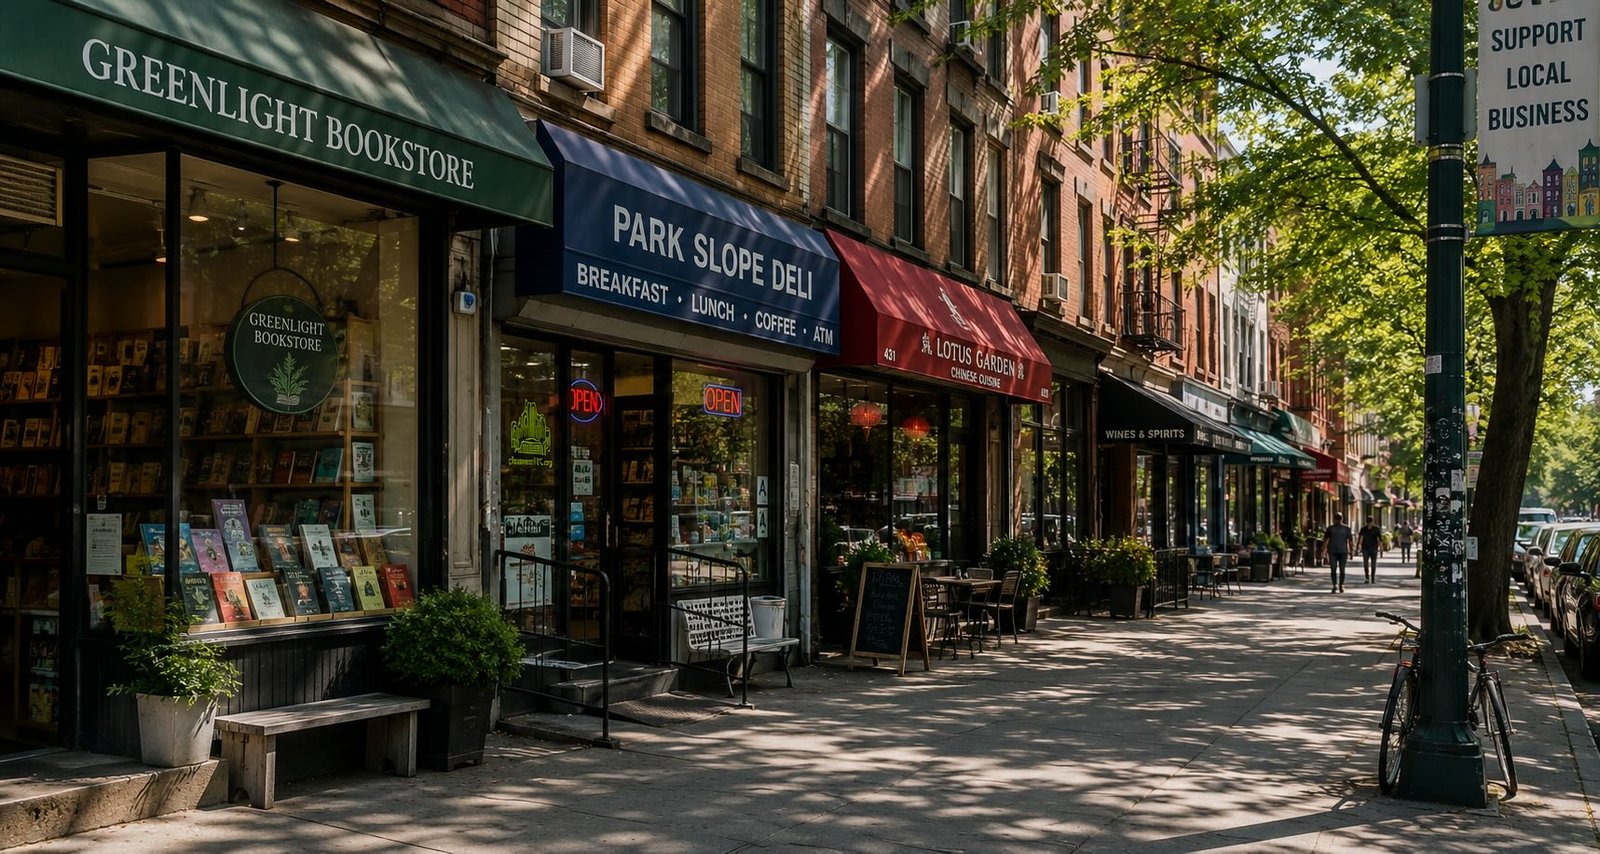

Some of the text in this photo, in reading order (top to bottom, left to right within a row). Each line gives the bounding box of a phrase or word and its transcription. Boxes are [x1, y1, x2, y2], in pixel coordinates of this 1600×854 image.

[1491, 18, 1586, 52] SUPPORT
[1507, 61, 1571, 90] LOCAL
[82, 38, 475, 190] GREENLIGHT BOOKSTORE
[1488, 98, 1589, 131] BUSINESS
[613, 204, 813, 300] PARK SLOPE DELI
[577, 262, 833, 346] BREAKFAST LUNCH COFFEE ATM
[249, 312, 325, 336] GREENLIGHT
[254, 330, 322, 352] BOOKSTORE
[884, 348, 896, 362] 431
[936, 338, 972, 365] LOTUS
[976, 350, 1015, 377] GARDEN
[951, 366, 977, 383] CHINESE
[705, 386, 740, 414] OPEN
[1105, 429, 1185, 439] WINES & SPIRITS
